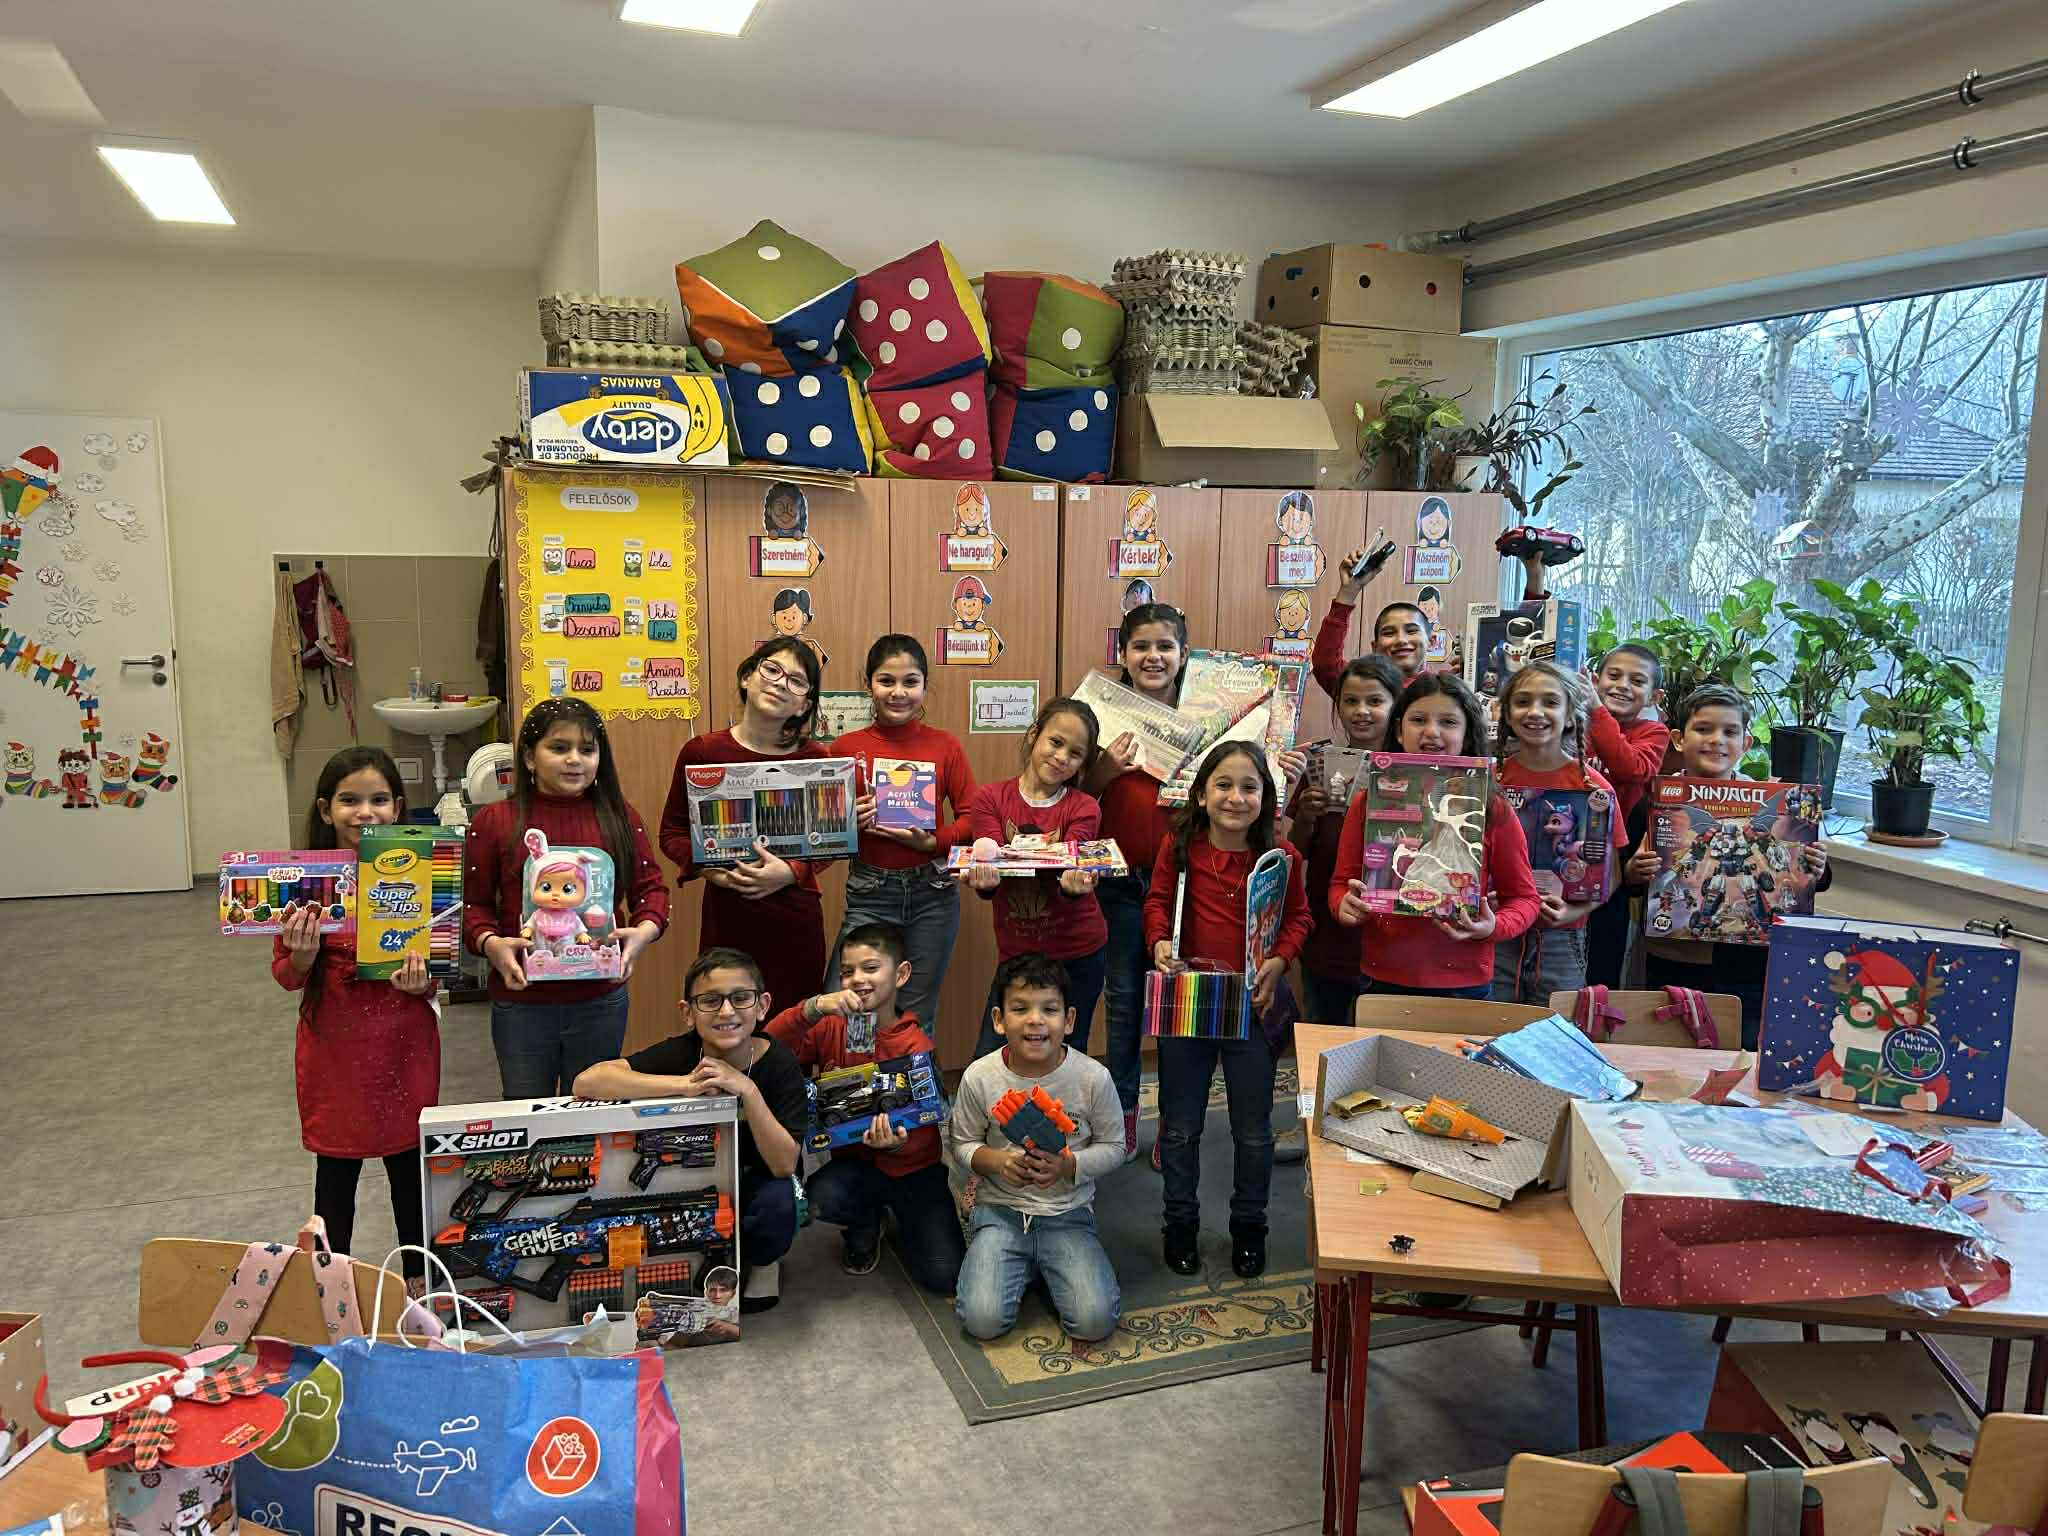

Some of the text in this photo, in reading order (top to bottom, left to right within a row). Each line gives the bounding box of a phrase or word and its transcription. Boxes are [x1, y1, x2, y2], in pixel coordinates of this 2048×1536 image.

[1390, 357, 1433, 368] DINING CHAIR
[600, 376, 662, 389] BANANAS
[612, 401, 652, 409] QUALITY
[590, 412, 675, 451] derby
[536, 445, 586, 453] COLOMBIA
[538, 452, 600, 461] PRODUCE OF
[762, 547, 807, 561] Szeretném!
[949, 543, 959, 558] Ne
[1120, 546, 1157, 565] Kérlek!
[646, 662, 683, 678] Amira
[691, 771, 722, 780] Maped
[887, 791, 919, 799] Acrylic
[1661, 785, 1682, 797] LEGO
[1686, 783, 1769, 808] NINJAGO
[887, 799, 920, 807] Marker
[1657, 816, 1672, 826] 9+
[362, 827, 374, 836] 24
[380, 852, 411, 864] Crayola
[369, 887, 416, 901] Super
[391, 900, 422, 914] Tips
[383, 934, 402, 947] 24
[1904, 1031, 1929, 1045] Merry
[1893, 1038, 1938, 1053] Christmas
[503, 1222, 562, 1251] GAME
[521, 1231, 579, 1257] OVER
